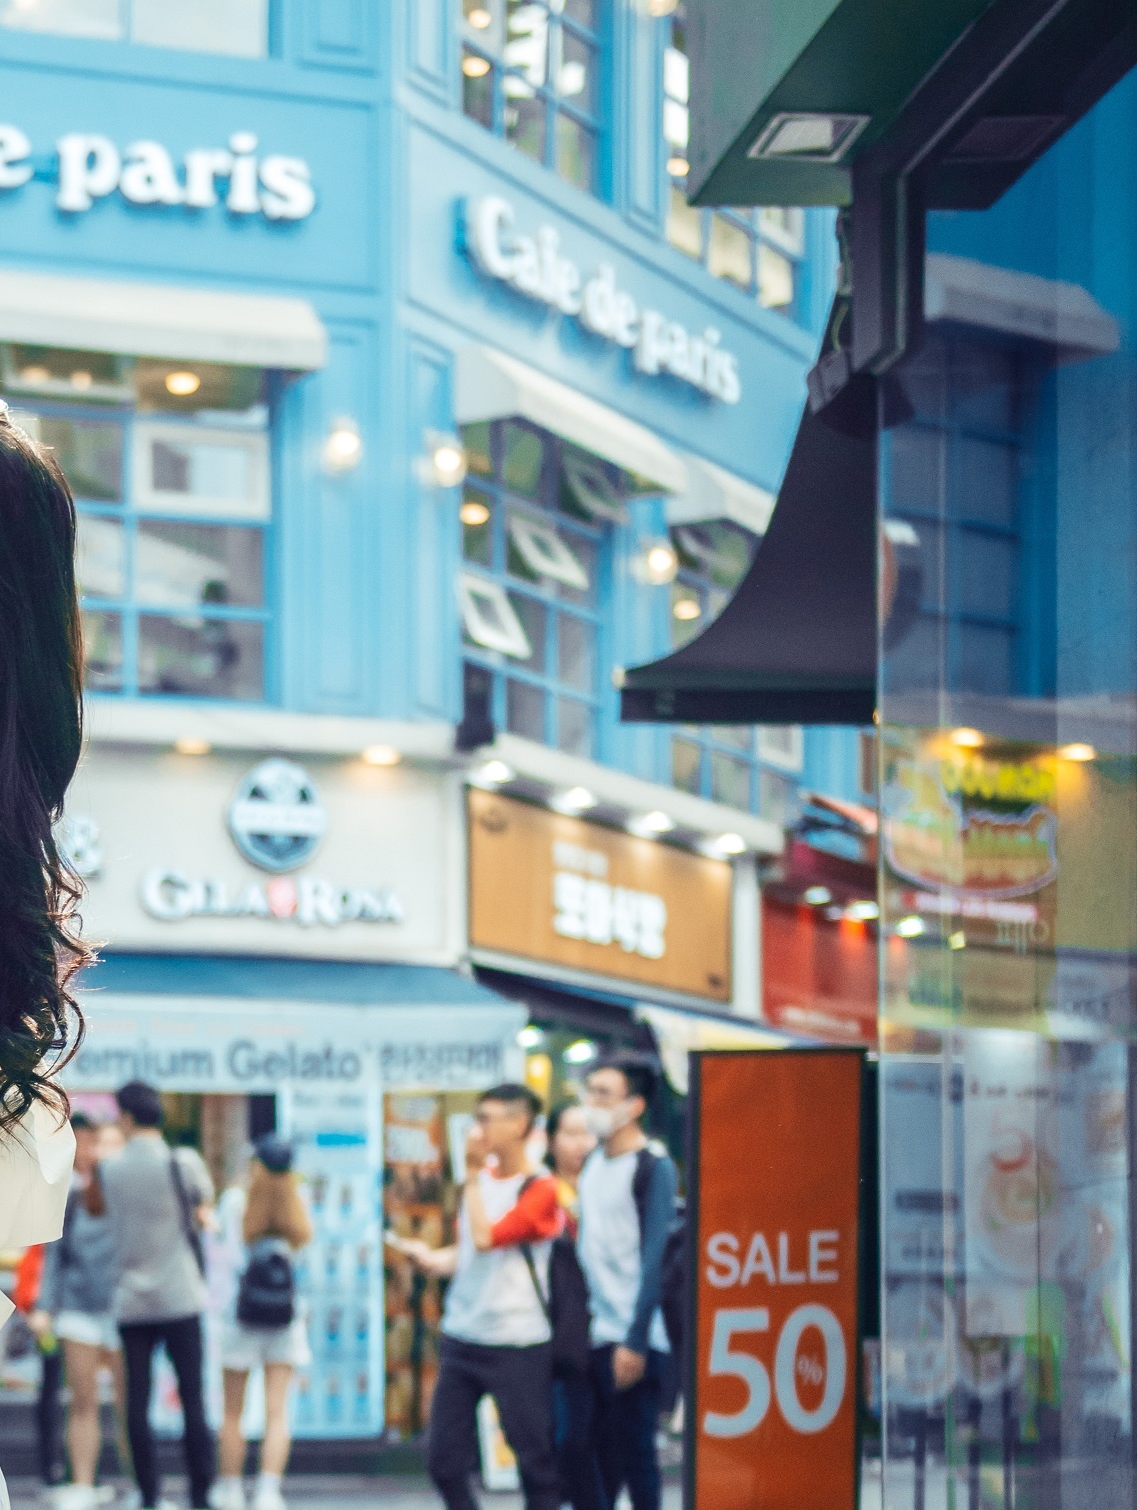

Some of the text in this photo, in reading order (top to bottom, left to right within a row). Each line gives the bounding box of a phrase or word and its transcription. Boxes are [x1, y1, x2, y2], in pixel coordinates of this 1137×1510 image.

[56, 131, 316, 220] paris
[476, 195, 741, 405] Cafe de paris
[75, 1037, 216, 1079] emium
[226, 1039, 359, 1081] Gelato
[706, 1230, 840, 1289] SALE
[703, 1304, 847, 1439] 50
